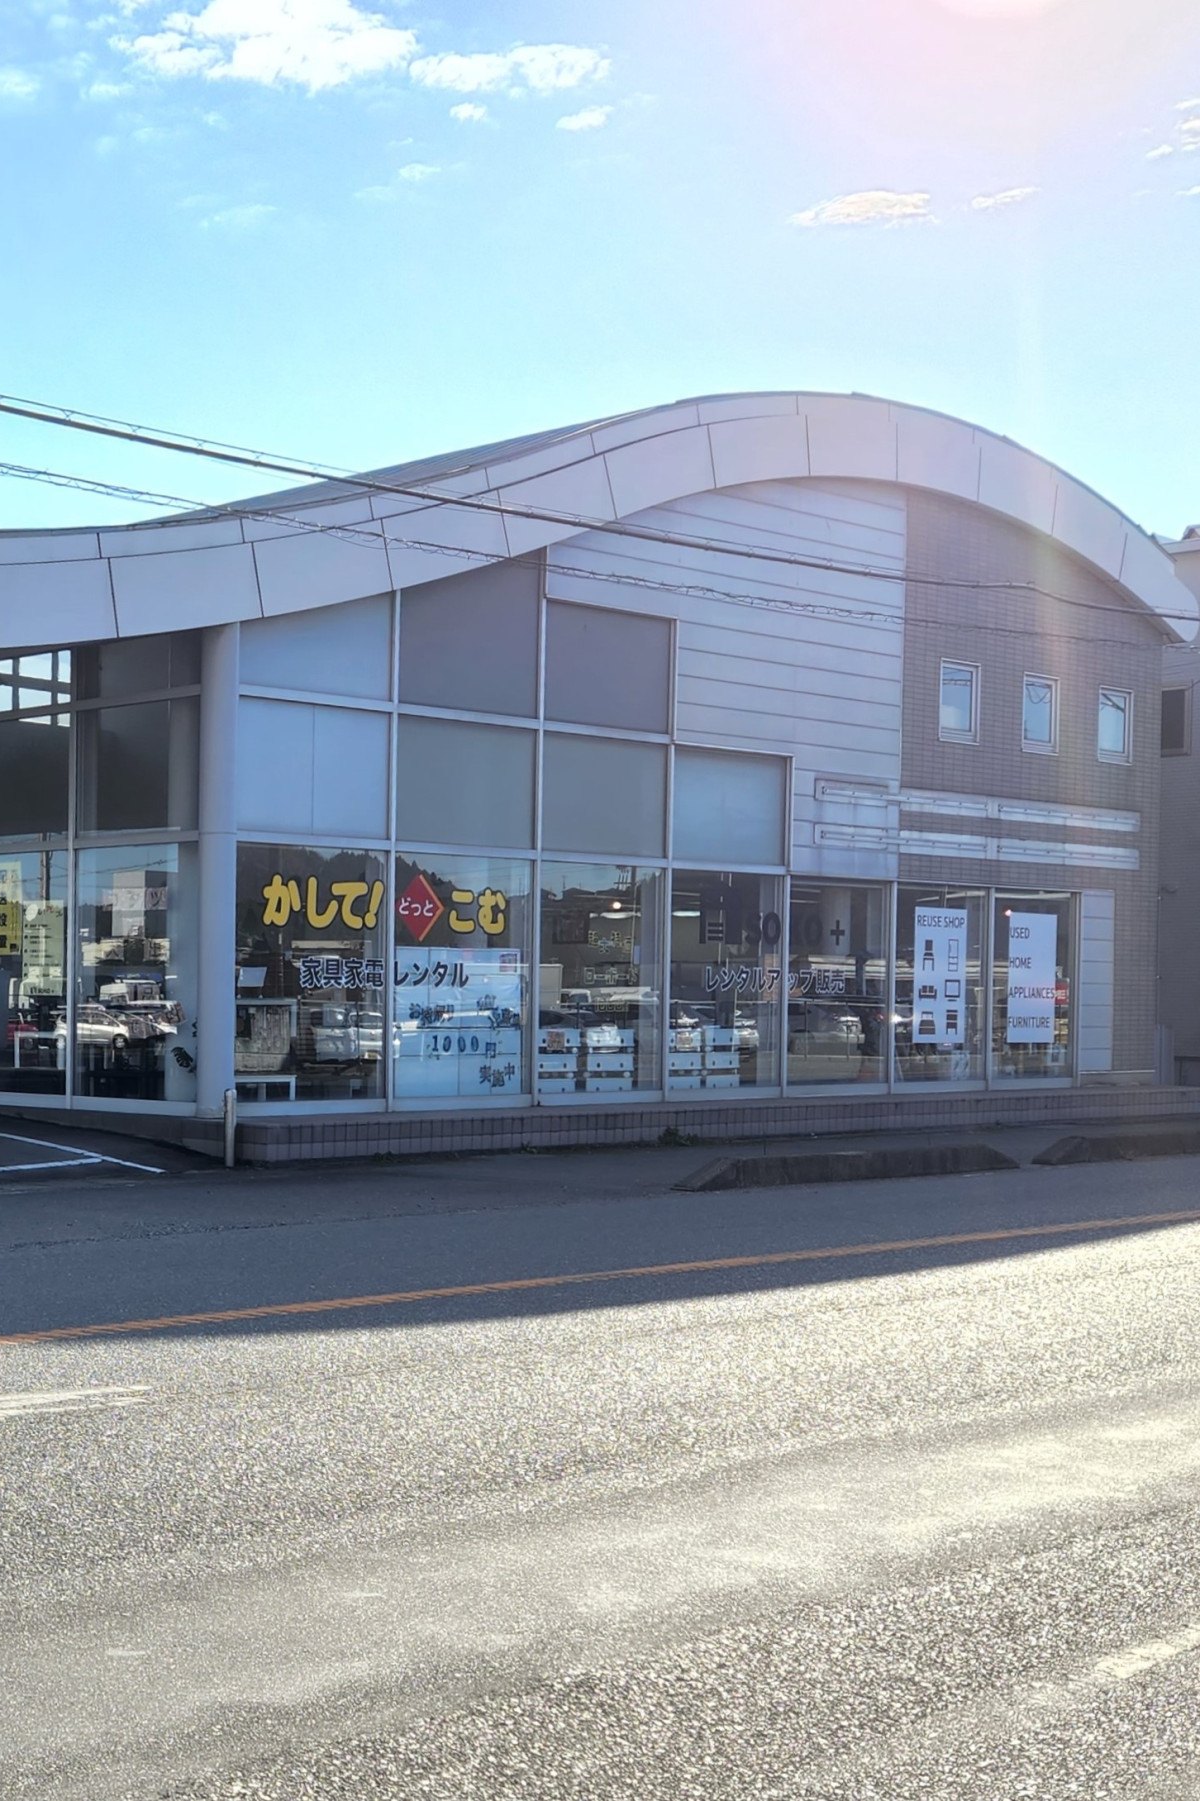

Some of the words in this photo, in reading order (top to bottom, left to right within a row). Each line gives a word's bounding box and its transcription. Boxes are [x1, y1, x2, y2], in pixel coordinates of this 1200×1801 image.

[261, 873, 385, 930] かして!
[398, 897, 434, 917] どっと
[449, 887, 507, 935] こむ
[917, 914, 942, 928] REUSE
[943, 915, 965, 929] SHOP
[1010, 927, 1030, 939] USED
[1009, 957, 1032, 969] HOME
[300, 957, 470, 989] 家具家電レンタル
[705, 965, 846, 994] レンタルアップ販売
[1008, 986, 1056, 1000] APPLIANCES
[1008, 1015, 1051, 1029] FURNITURE
